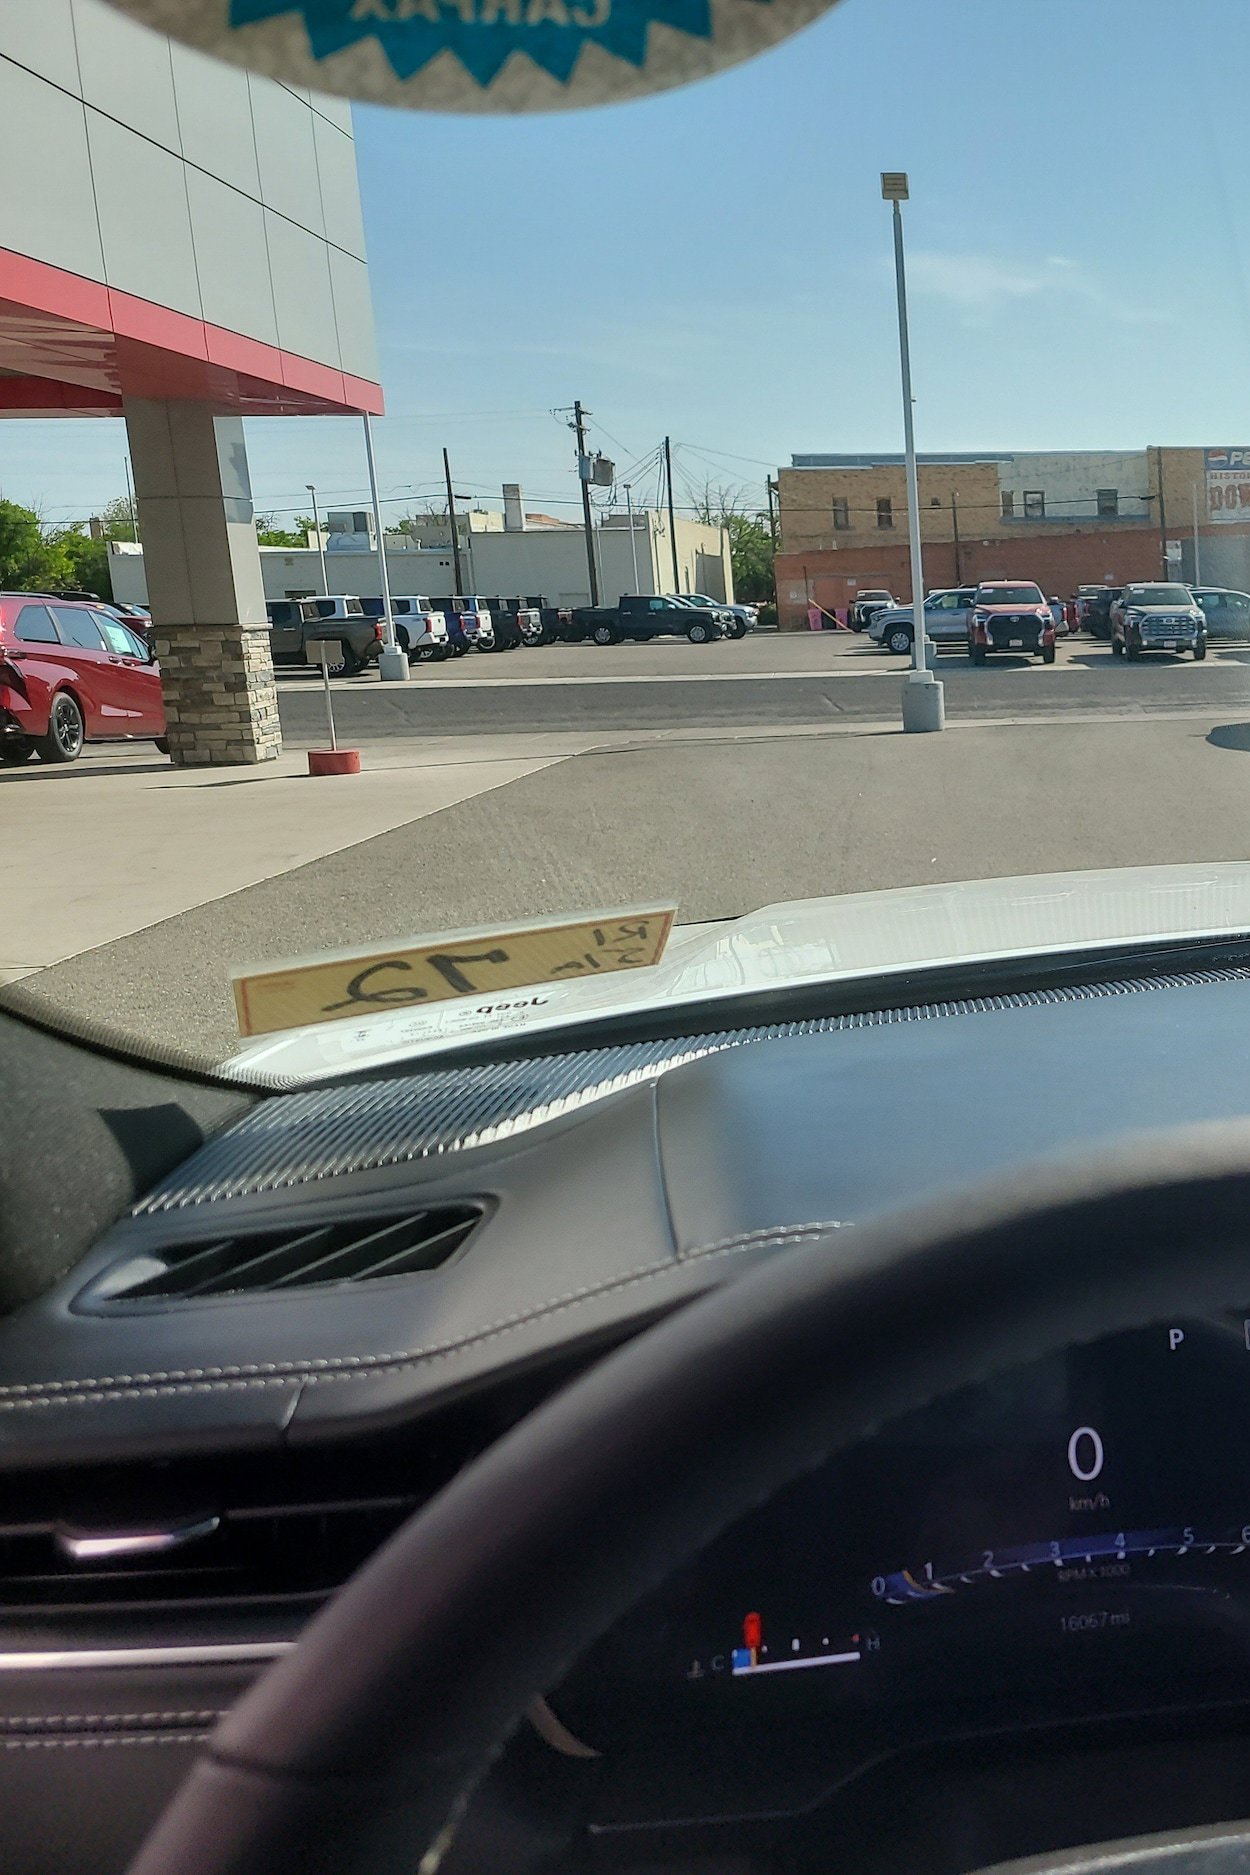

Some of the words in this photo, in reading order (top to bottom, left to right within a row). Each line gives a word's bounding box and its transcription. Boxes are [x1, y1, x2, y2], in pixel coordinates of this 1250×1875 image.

[1168, 1329, 1185, 1350] P
[1067, 1426, 1104, 1482] 0
[1068, 1492, 1110, 1512] km/h
[1114, 1532, 1126, 1548] 4
[1183, 1526, 1195, 1545] 5
[1049, 1540, 1061, 1557] 3
[982, 1551, 995, 1568] 2
[924, 1562, 934, 1580] 1
[871, 1577, 886, 1594] 0
